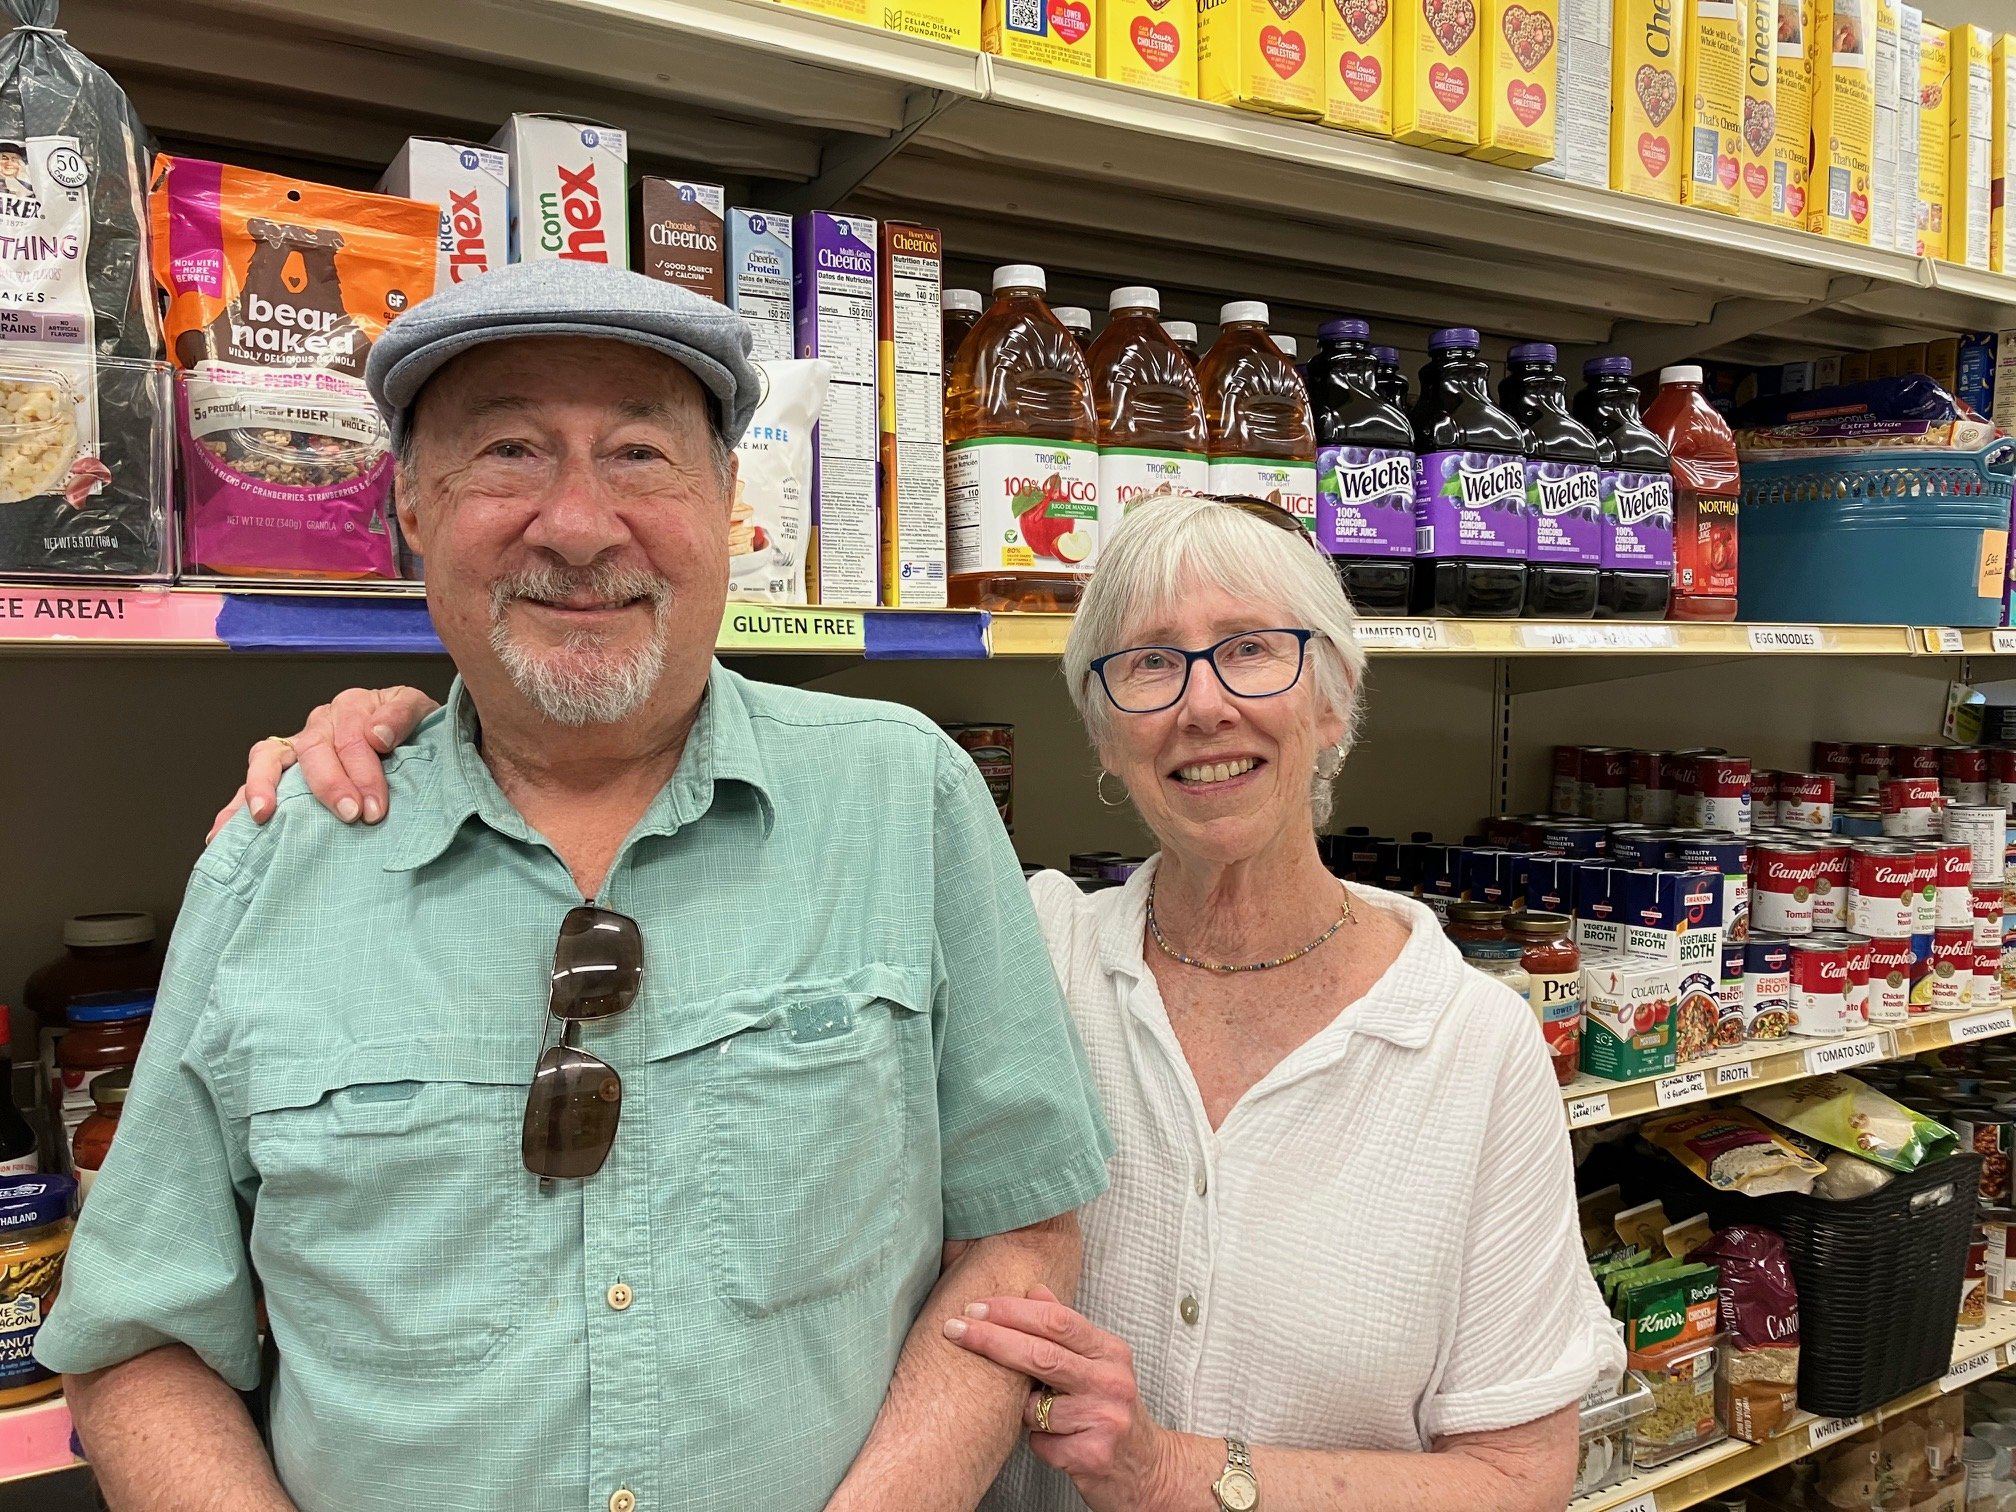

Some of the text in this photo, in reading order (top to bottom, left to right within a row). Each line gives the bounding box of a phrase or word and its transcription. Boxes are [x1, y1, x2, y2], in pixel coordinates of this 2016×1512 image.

[1064, 8, 1082, 20] LOWER
[905, 17, 960, 35] CELIAC DISEASE
[905, 25, 951, 40] FOUNDATION
[1137, 38, 1174, 53] CHOLESTEROL
[1266, 46, 1300, 61] CHOLESTEROL
[1444, 73, 1464, 86] lower
[56, 155, 79, 173] 50
[54, 169, 84, 183] CALORIES
[558, 163, 608, 263] hex
[540, 192, 563, 252] Corn
[665, 220, 696, 232] Chocolate
[440, 214, 454, 251] Rice
[449, 189, 488, 283] Chex
[650, 224, 717, 251] Cheerios
[893, 234, 937, 253] Cheerios
[748, 253, 778, 265] Cheerios
[819, 249, 871, 271] Cheerios
[894, 256, 938, 267] Nutrition Facts
[665, 262, 713, 274] GOOD SOURCE
[748, 263, 780, 275] Protein
[176, 273, 217, 284] BERRIES
[676, 272, 704, 280] CALCIUM
[765, 277, 790, 286] Nutrición
[389, 293, 405, 308] GF
[929, 293, 939, 301] 210
[249, 294, 337, 332] bear
[768, 310, 790, 319] 150 210
[849, 307, 872, 317] 150 210
[231, 324, 354, 354] naked
[229, 347, 262, 360] WILDLY
[264, 353, 314, 364] DELICIOUS
[194, 407, 207, 421] 5g
[287, 407, 329, 422] FIBER
[341, 420, 366, 433] WHOLE
[1840, 422, 1870, 430] Extra
[1035, 454, 1071, 465] TROPICAL
[1147, 463, 1181, 474] TROPICAL
[1258, 472, 1290, 481] TROPICAL
[1340, 459, 1411, 499] Welch's
[218, 471, 240, 487] BLEND
[241, 481, 252, 491] OF
[252, 485, 307, 501] CRANBERRIES,
[308, 486, 359, 502] STRAWBERRIES
[1004, 477, 1040, 496] 100%
[1463, 466, 1522, 501] Welch's
[968, 489, 978, 497] 110
[1541, 475, 1597, 510] Welch's
[1618, 484, 1669, 518] Welch's
[1072, 504, 1095, 512] MANZANA
[1336, 508, 1361, 518] 100%
[1460, 511, 1481, 521] 100%
[227, 515, 336, 531] NET WT 12 OZ (340g) GRANOLA
[1336, 519, 1366, 527] CONCORD
[1460, 521, 1486, 530] CONCORD
[1537, 518, 1558, 528] 100%
[1698, 522, 1711, 532] 100%
[1336, 527, 1377, 537] GRAPE JUICE
[1460, 530, 1495, 539] GRAPE JUICE
[1537, 528, 1563, 537] CONCORD
[1615, 528, 1634, 536] 100%
[1698, 531, 1710, 539] JUICE
[44, 538, 58, 549] NET
[59, 537, 70, 548] WT
[73, 537, 84, 548] 5.9
[85, 536, 95, 547] OZ
[96, 536, 110, 548] (168
[1537, 536, 1571, 546] GRAPE JUICE
[34, 599, 124, 619] AREA!
[734, 616, 856, 635] GLUTEN FREE
[1405, 628, 1420, 638] TO
[1423, 626, 1436, 640] (2)
[1754, 633, 1815, 646] EGG NOODLES
[1999, 638, 2013, 648] MAC
[1685, 894, 1711, 904] SWANSON
[1583, 923, 1617, 932] VEGETABLE
[1584, 931, 1615, 942] BROTH
[1630, 929, 1667, 940] VEGETABLE
[1680, 933, 1717, 945] VEGETABLE
[1630, 937, 1666, 949] BROTH
[1680, 944, 1715, 960] BROTH
[1631, 982, 1670, 998] COLAVITA
[1932, 989, 1957, 997] Noodle
[1592, 996, 1617, 1005] COLAVITA
[1553, 1006, 1572, 1015] LOWER
[1962, 1019, 2010, 1037] CHICKEN NOODLE
[1817, 1043, 1876, 1063] TOMATO SOUP
[1720, 1067, 1749, 1081] BROTH
[1690, 1083, 1704, 1094] FREE
[1573, 1102, 1584, 1110] LOW
[1639, 1312, 1685, 1333] Knorr
[1949, 1353, 1989, 1379] AKED BEANS
[1814, 1422, 1841, 1439] WHITE
